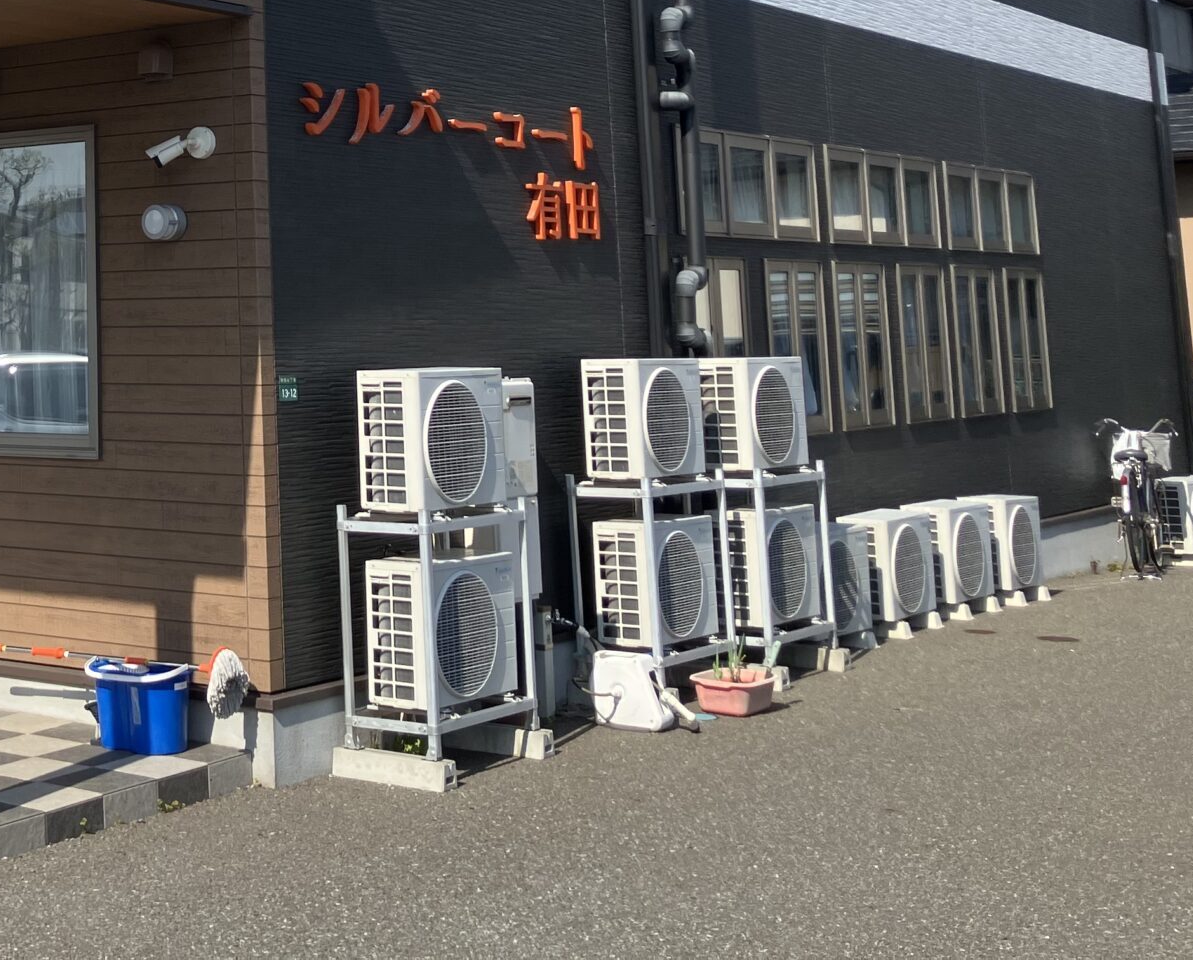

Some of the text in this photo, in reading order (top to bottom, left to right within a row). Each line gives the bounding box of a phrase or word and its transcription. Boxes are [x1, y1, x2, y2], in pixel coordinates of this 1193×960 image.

[299, 82, 594, 170] シルバーコート
[525, 172, 601, 240] 有田
[281, 388, 297, 399] 13-12
